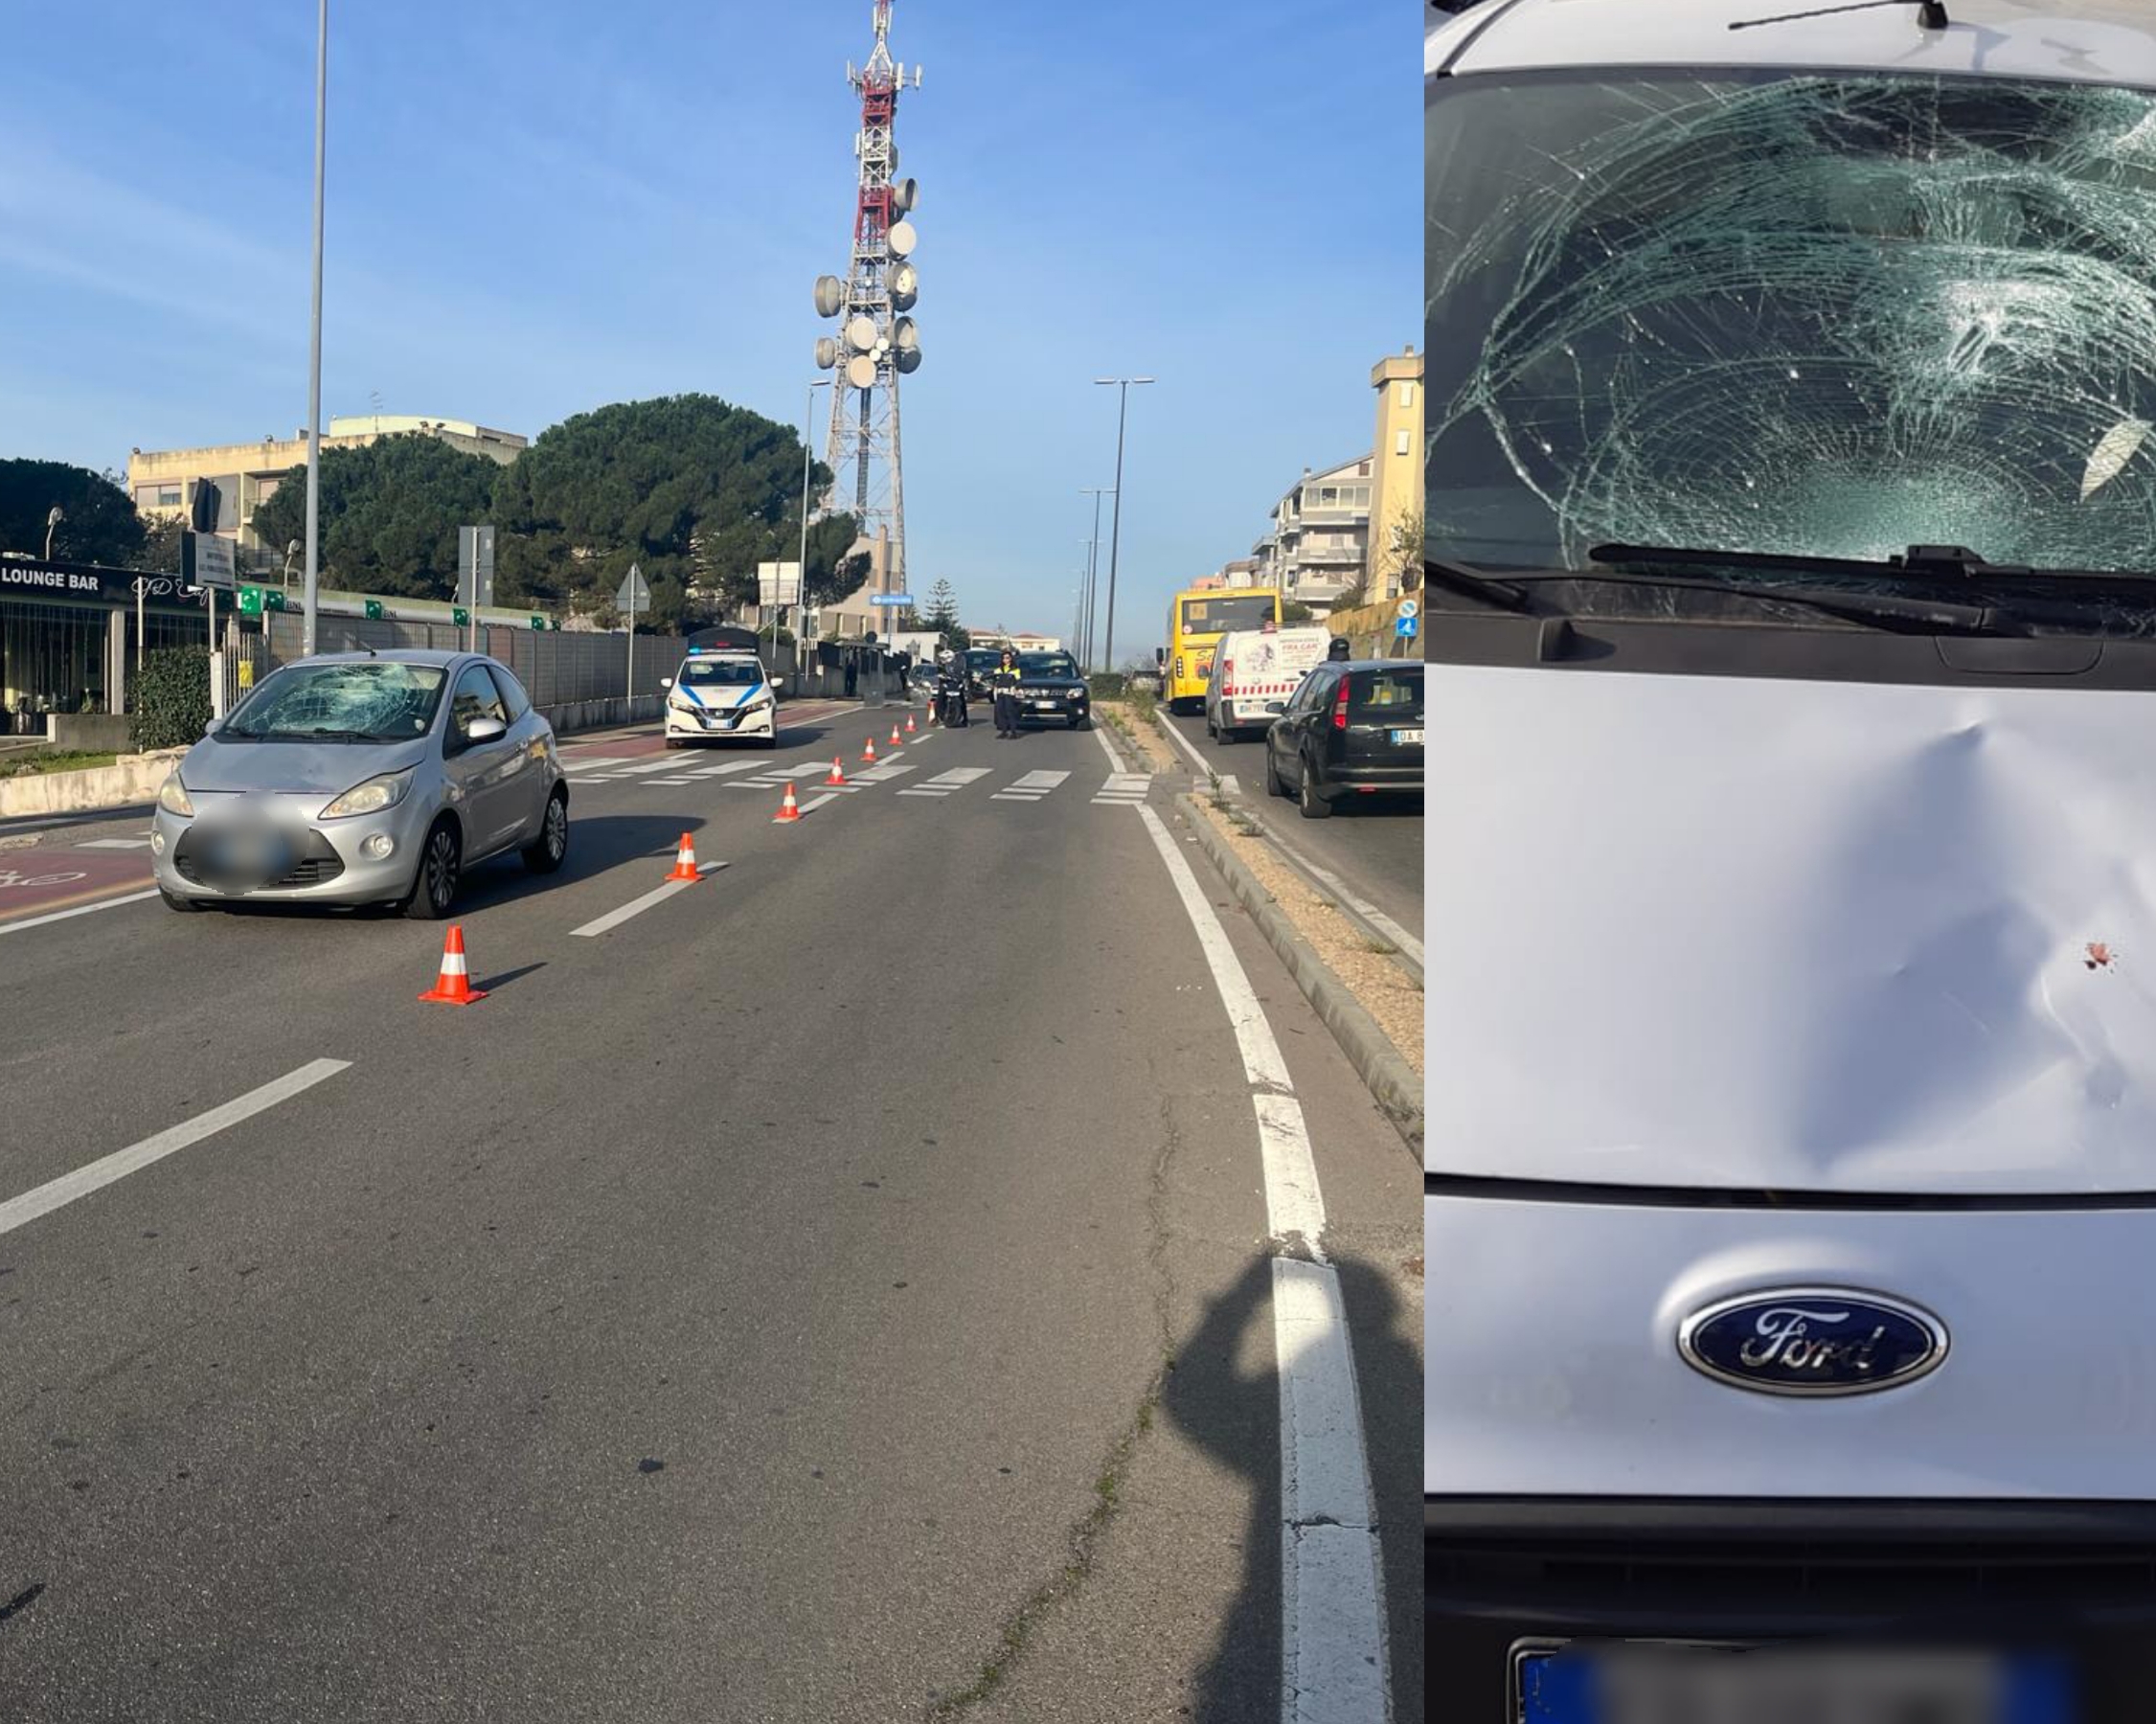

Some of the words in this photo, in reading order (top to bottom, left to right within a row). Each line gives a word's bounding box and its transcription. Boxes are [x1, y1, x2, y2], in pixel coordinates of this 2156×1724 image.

[2, 567, 65, 587] LOUNGE
[68, 574, 99, 590] BAR
[1740, 1306, 1887, 1370] Ford
